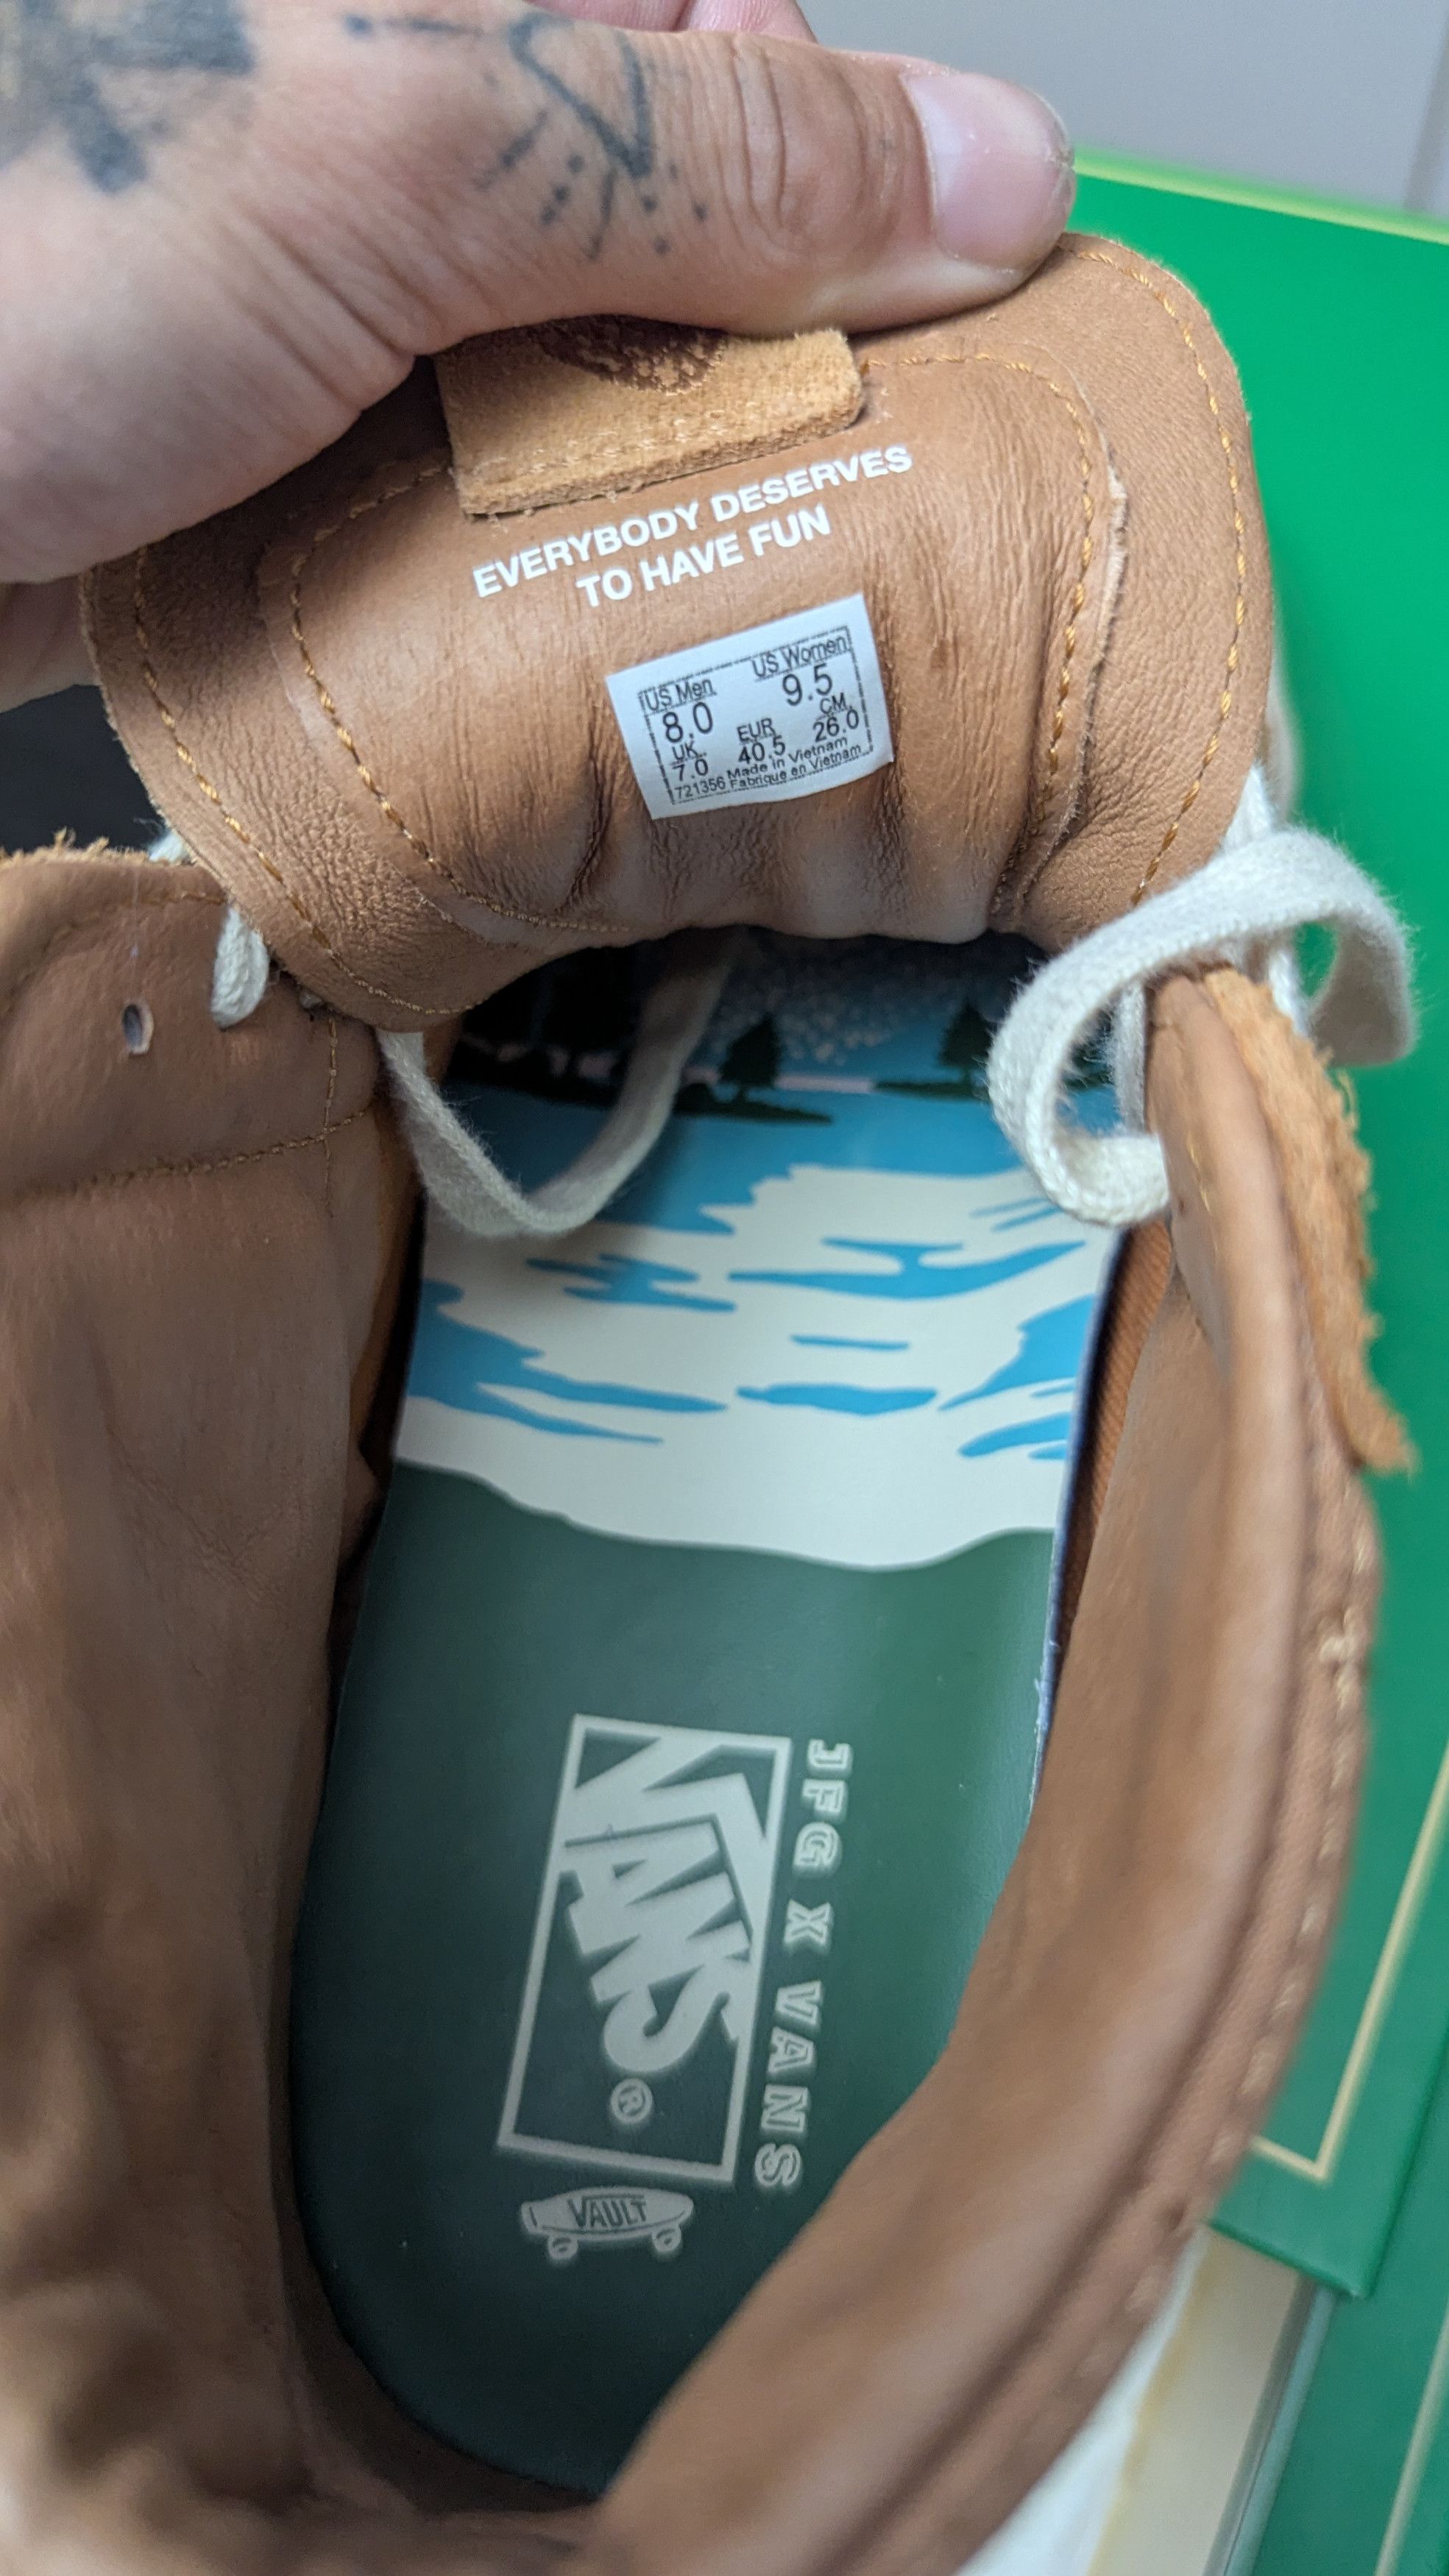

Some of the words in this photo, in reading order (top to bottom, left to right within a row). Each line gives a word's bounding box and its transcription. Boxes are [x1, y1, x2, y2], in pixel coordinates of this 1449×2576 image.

[472, 502, 701, 598] EVERYBODY
[709, 444, 913, 522] DESERVES
[575, 569, 632, 607] TO
[640, 531, 744, 591] HAVE
[749, 504, 832, 556] FUN
[752, 656, 779, 678] US
[782, 634, 848, 667] Women
[644, 689, 670, 712] US
[677, 679, 713, 703] Men
[782, 663, 833, 706] 9.5
[662, 701, 713, 743] 8.0
[737, 718, 775, 742] EUR
[813, 709, 859, 743] 26.0
[672, 740, 699, 762] UK
[673, 759, 708, 782] 7.0
[726, 762, 767, 779] Made
[771, 757, 784, 771] in
[787, 737, 848, 763] Vietnam
[730, 771, 787, 790] Fabrique
[790, 765, 807, 777] en
[809, 745, 862, 771] Vietnam
[738, 735, 786, 765] 40.5
[675, 776, 726, 799] 721356
[793, 1738, 852, 1871] JFG
[548, 1719, 787, 2076] VANS
[784, 1897, 832, 1953] X
[754, 1978, 825, 2189] VANS
[567, 2193, 648, 2232] VAULT
